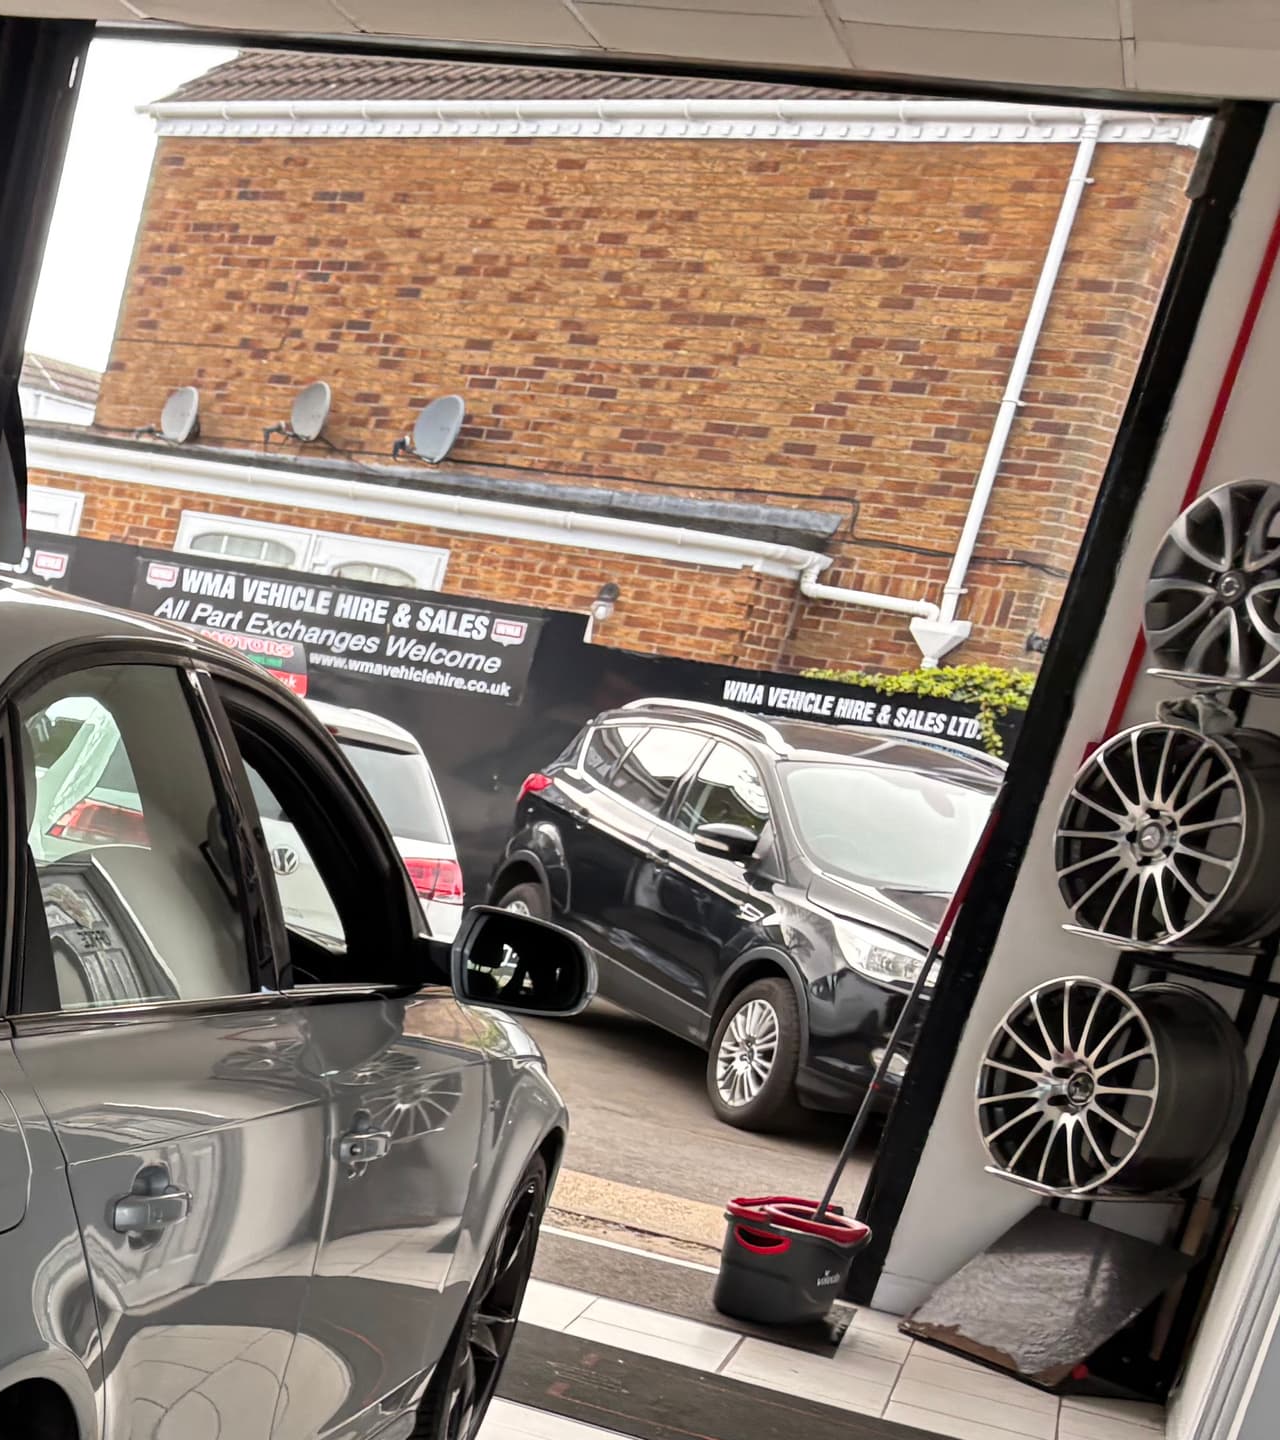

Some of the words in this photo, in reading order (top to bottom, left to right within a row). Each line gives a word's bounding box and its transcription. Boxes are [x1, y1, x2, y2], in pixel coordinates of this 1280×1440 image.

[154, 597, 188, 621] All
[191, 603, 242, 630] Part
[245, 612, 381, 655] Exchanges
[386, 635, 502, 674] Welcome
[181, 568, 236, 600] WMA
[242, 577, 332, 616] VEHICLE
[334, 593, 390, 624] HIRE
[392, 603, 411, 628] &
[416, 606, 489, 640] SALES
[309, 652, 512, 697] www.wmavehiclehire.co.uk
[722, 680, 765, 705] WMA
[767, 686, 836, 716] VEHICLE
[834, 698, 876, 722] HIRE
[876, 704, 892, 725] &
[893, 707, 947, 734] SALES
